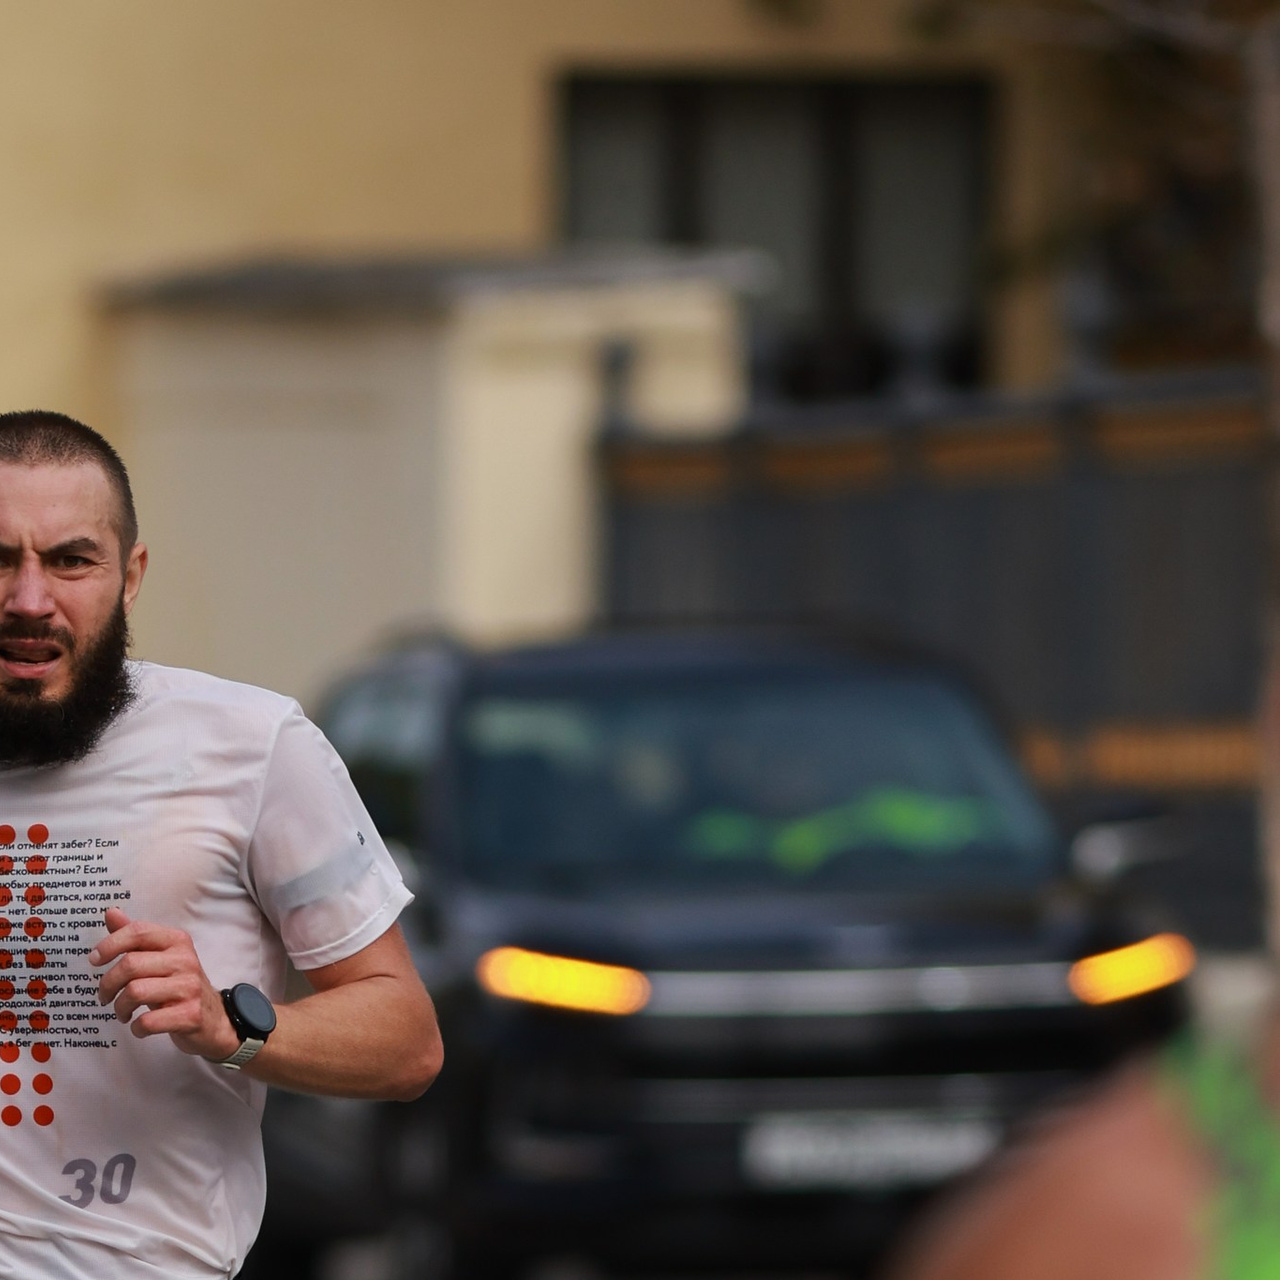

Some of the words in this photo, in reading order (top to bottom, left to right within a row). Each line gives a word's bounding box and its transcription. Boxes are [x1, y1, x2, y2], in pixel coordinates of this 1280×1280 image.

[17, 842, 59, 850] отменят
[60, 839, 93, 849] забег?
[95, 839, 119, 848] Если
[8, 855, 50, 864] закроют
[52, 855, 94, 863] границы
[0, 866, 81, 876] бесконтактным?
[83, 865, 108, 874] Если
[32, 880, 87, 889] предметов
[98, 879, 122, 887] этих
[30, 894, 82, 903] двигаться,
[83, 893, 111, 901] когда
[113, 889, 131, 900] всё
[8, 908, 28, 916] нет.
[30, 906, 67, 915] Больше
[70, 906, 98, 915] всего
[59, 920, 65, 928] с
[67, 974, 92, 982] того,
[41, 986, 65, 994] себе
[74, 985, 100, 996] буду
[48, 1000, 98, 1008] двигаться.
[17, 1013, 50, 1021] вместе
[66, 1013, 89, 1021] всем
[0, 1025, 7, 1034] С
[9, 1028, 81, 1036] уверенностью,
[16, 1038, 32, 1048] бег
[64, 1039, 110, 1049] Наконец,
[58, 1153, 136, 1209] 30
